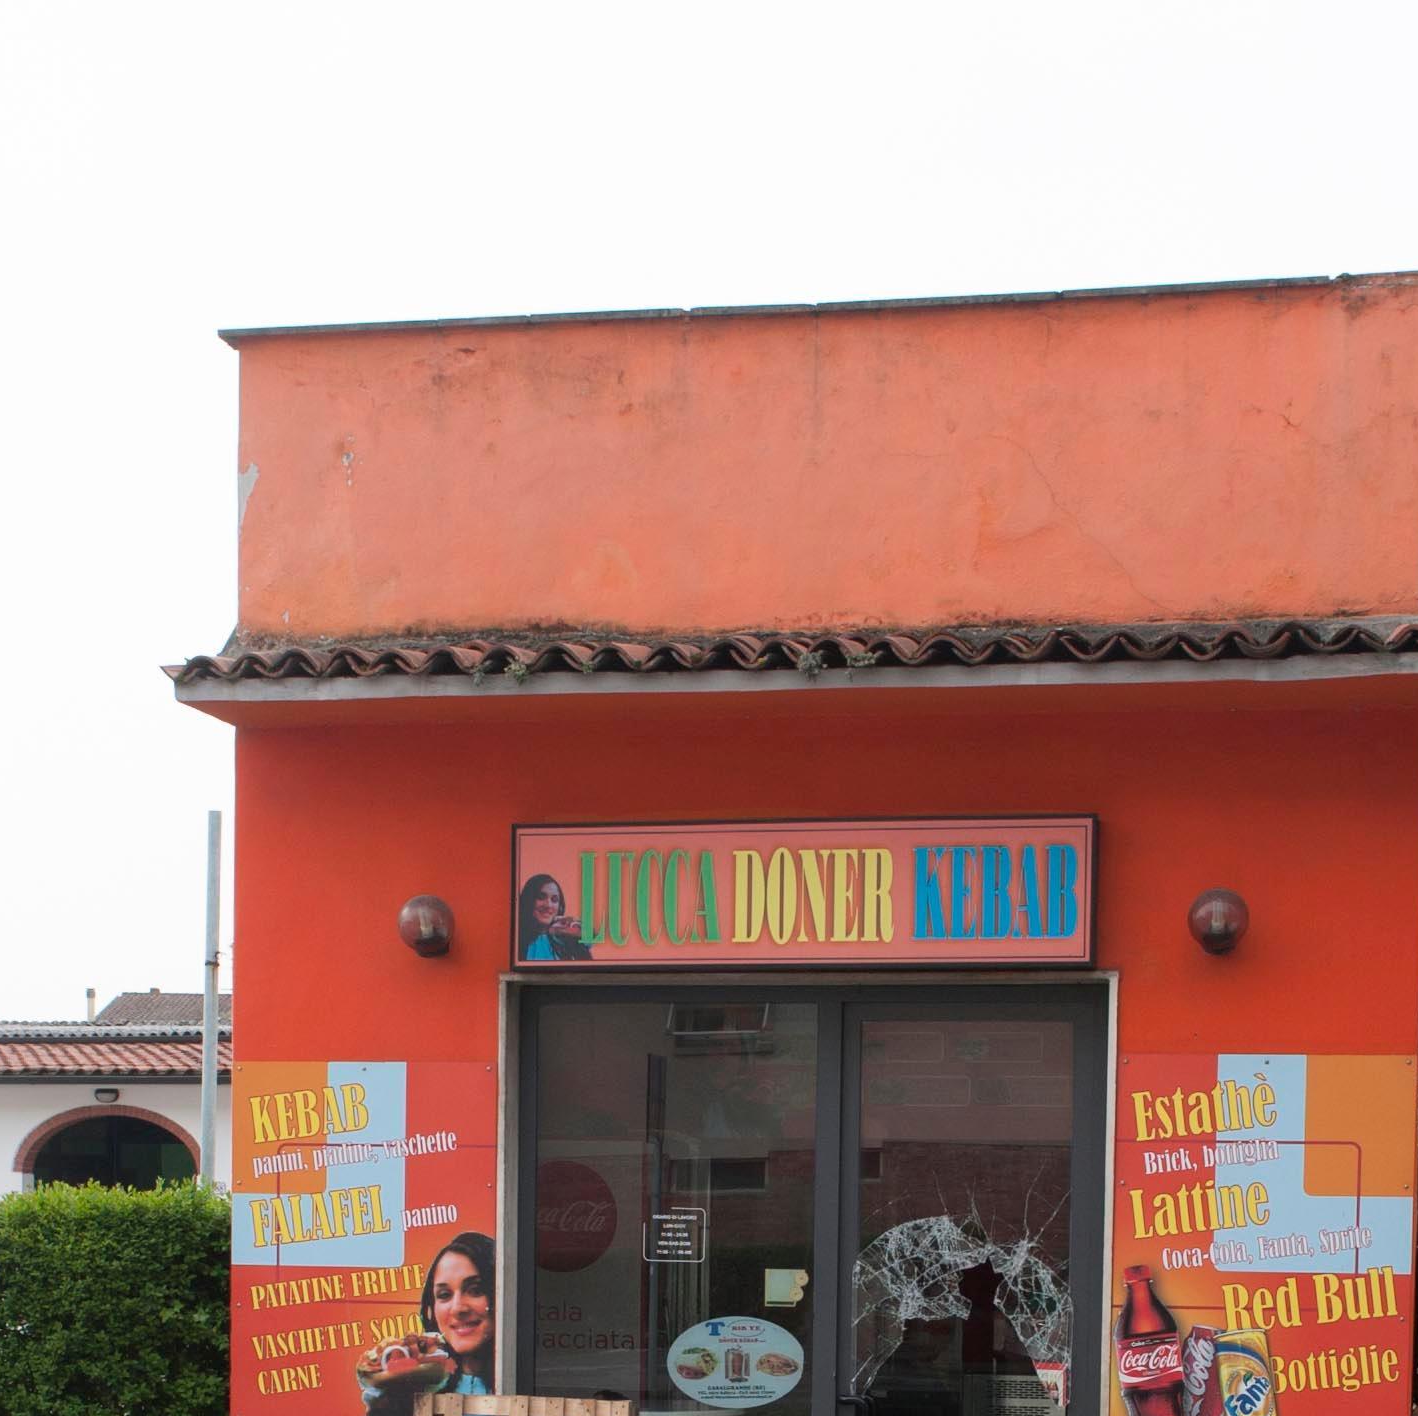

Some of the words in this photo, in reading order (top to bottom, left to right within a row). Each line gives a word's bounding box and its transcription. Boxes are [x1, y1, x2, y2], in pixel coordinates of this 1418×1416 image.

[578, 848, 722, 946] LUCCA
[732, 847, 895, 945] DONER
[912, 844, 1079, 941] KEBAB
[249, 1083, 369, 1144] KEBAB
[1131, 1072, 1277, 1142] Estathè
[313, 1142, 378, 1171] piadine,
[383, 1131, 457, 1159] vaschette
[1143, 1147, 1198, 1175] Brick,
[1202, 1137, 1280, 1168] bottiglia
[249, 1184, 391, 1248] FALAFEL
[402, 1203, 458, 1232] panino
[1129, 1180, 1271, 1240] Lattine
[1162, 1240, 1253, 1271] Coca-Cola,
[1257, 1232, 1314, 1261] Fanta,
[1319, 1226, 1373, 1256] Sprite
[250, 1274, 346, 1310] PATATINE
[350, 1263, 425, 1298] FRITTE
[1221, 1277, 1302, 1331] Red
[1312, 1265, 1399, 1325] Bull
[251, 1320, 365, 1361] VASCHETTE
[369, 1312, 425, 1344] SOLO
[1121, 1344, 1181, 1374] Coca-Cola
[257, 1364, 323, 1396] CARNE
[1271, 1344, 1400, 1394] Bottiglie
